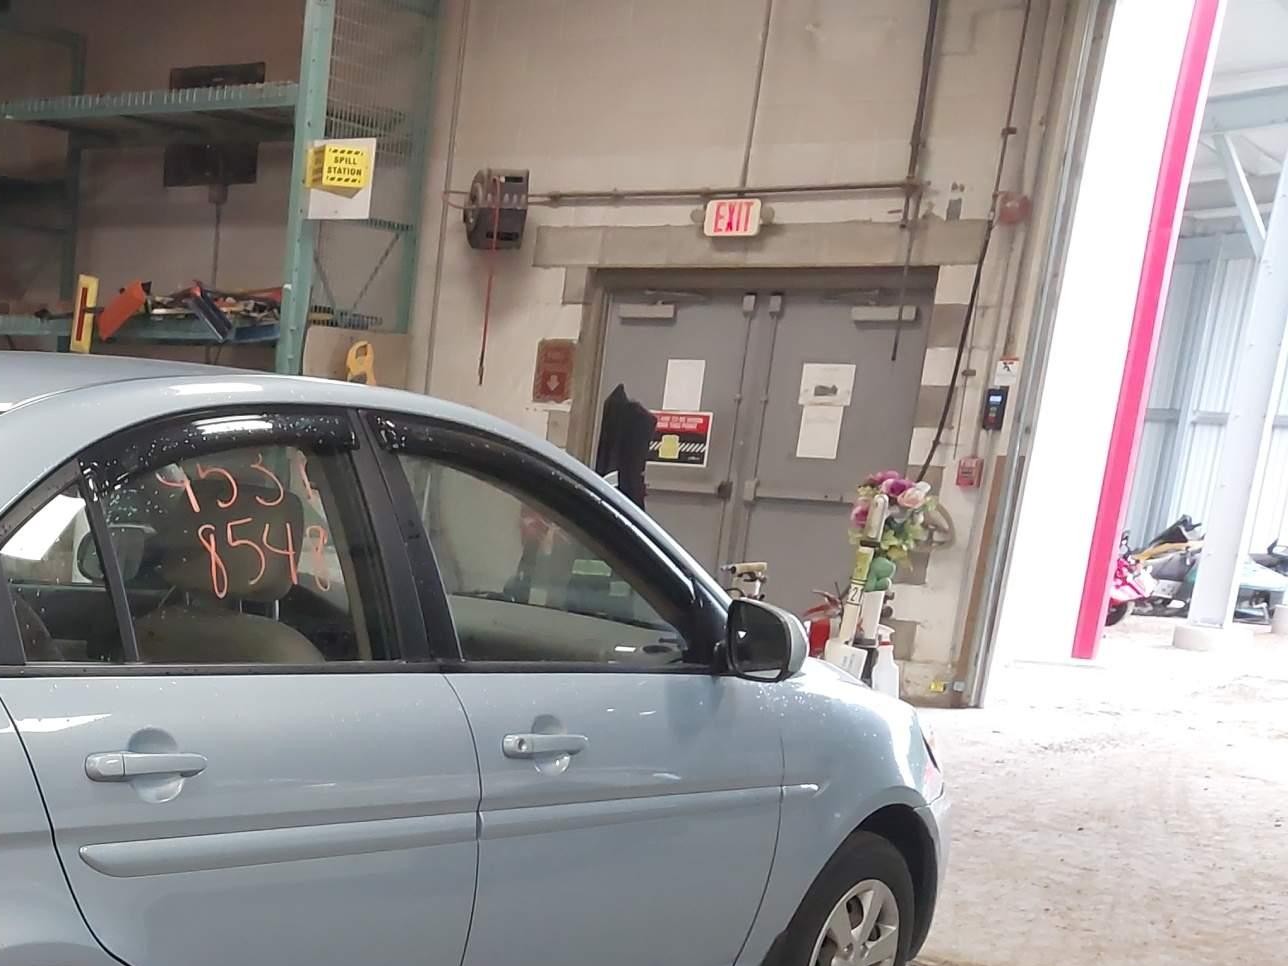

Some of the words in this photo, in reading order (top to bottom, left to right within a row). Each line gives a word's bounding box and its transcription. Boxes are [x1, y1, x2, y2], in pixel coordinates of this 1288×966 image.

[334, 156, 357, 165] SPILL
[327, 166, 362, 176] STATION
[713, 201, 754, 232] EXIT
[198, 518, 330, 599] 8548
